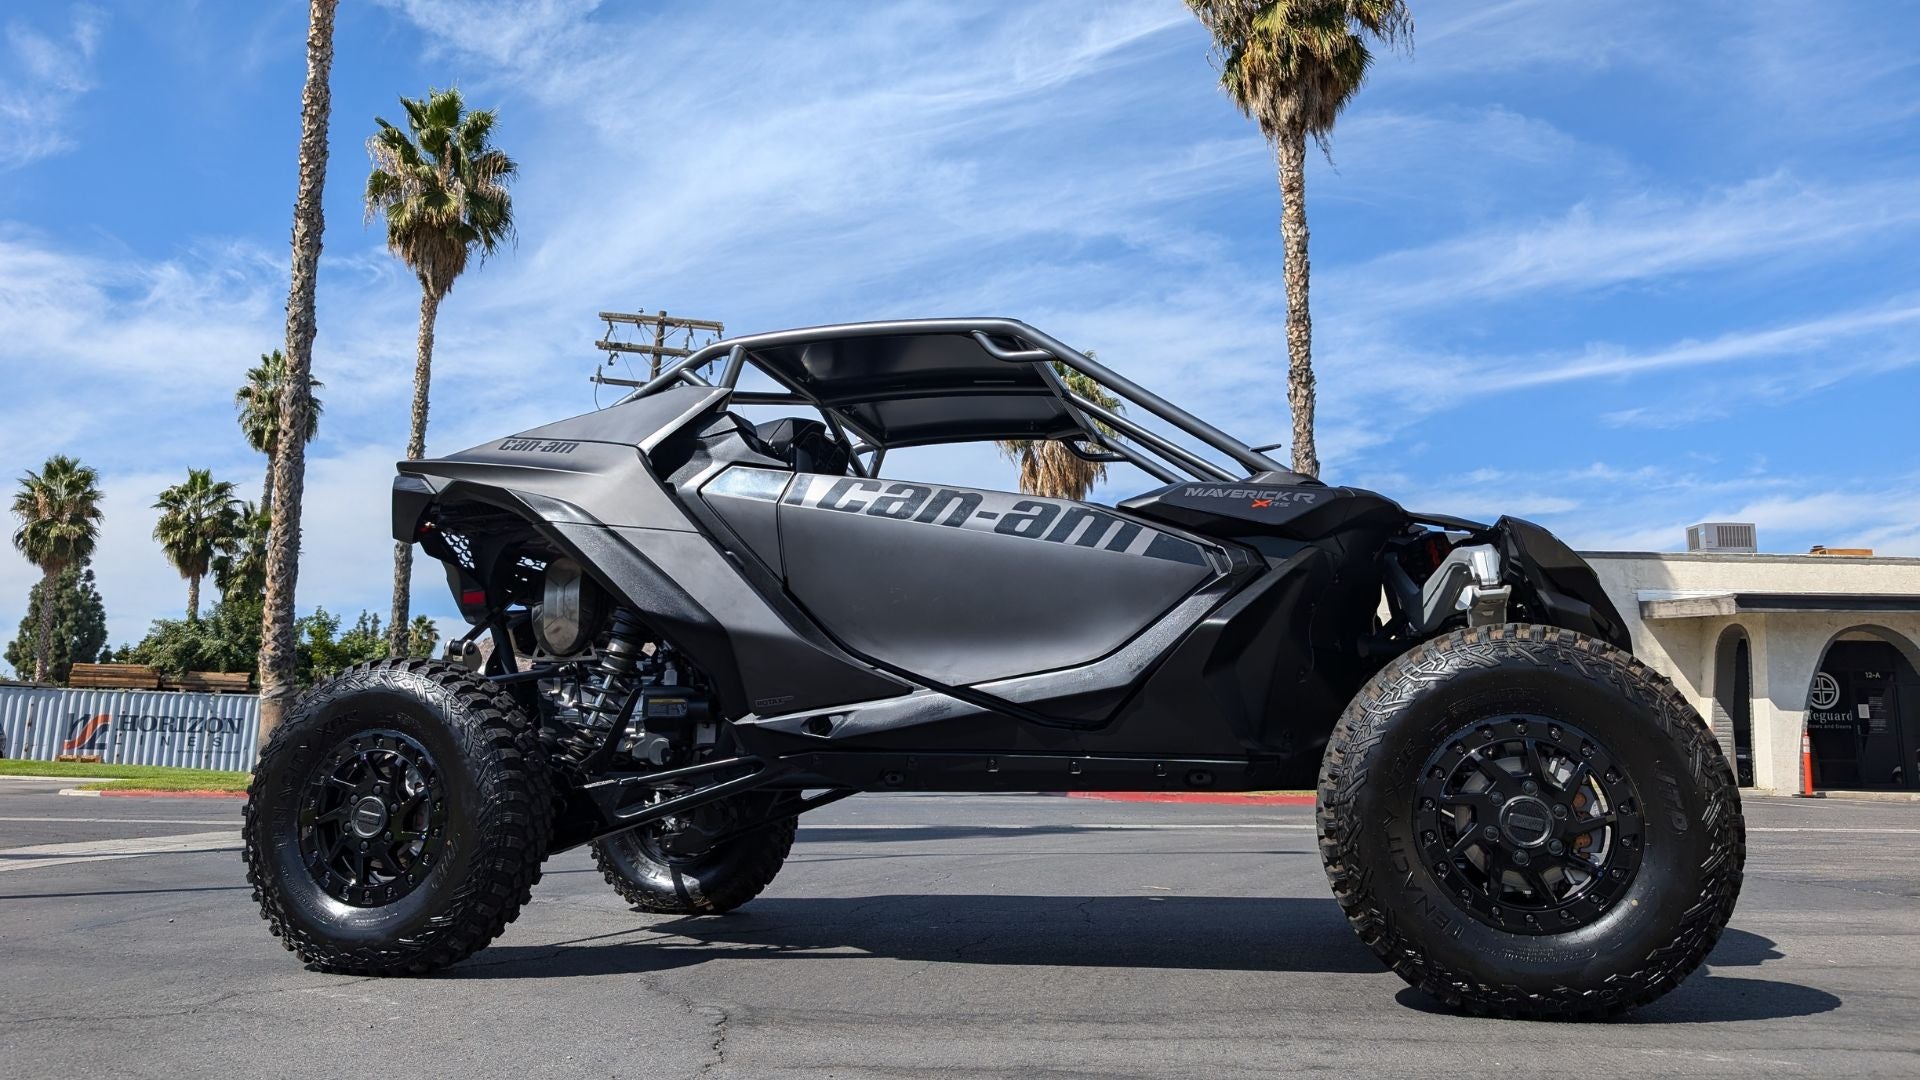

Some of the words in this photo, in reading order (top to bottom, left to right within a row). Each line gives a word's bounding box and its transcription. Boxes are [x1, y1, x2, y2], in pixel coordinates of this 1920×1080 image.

[498, 439, 580, 454] can-am
[1184, 486, 1292, 502] MAVERICK
[1294, 492, 1316, 504] R
[816, 477, 1145, 554] can-am
[1864, 671, 1881, 679] 12-A
[115, 714, 244, 735] HORIZON
[114, 734, 223, 748] LINES
